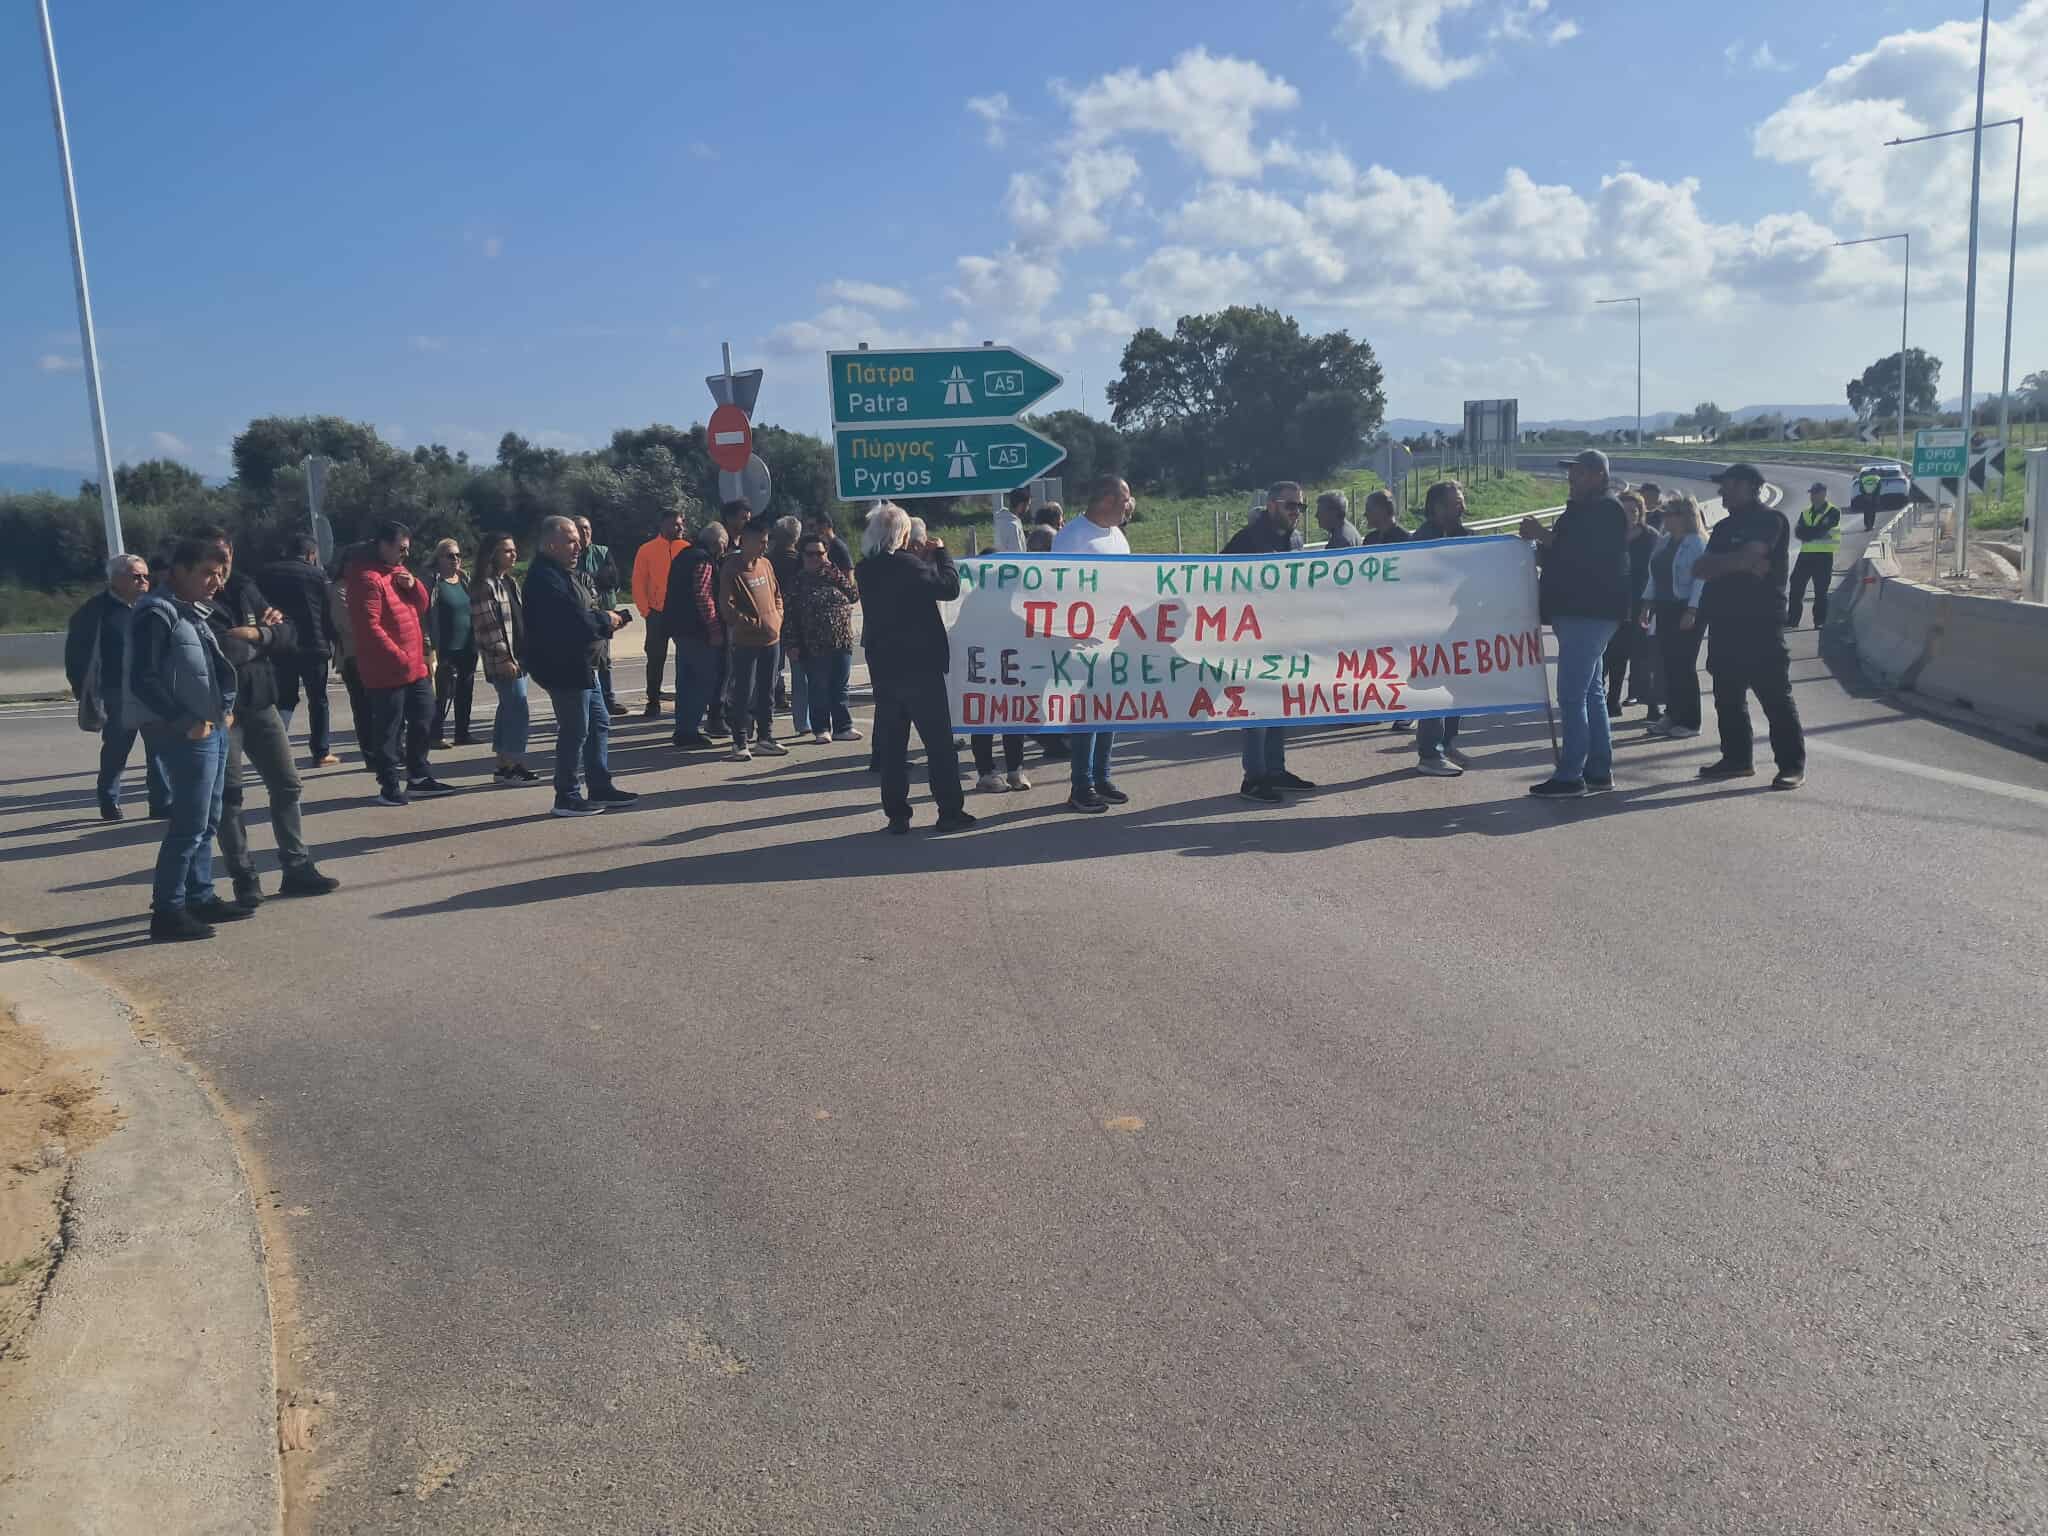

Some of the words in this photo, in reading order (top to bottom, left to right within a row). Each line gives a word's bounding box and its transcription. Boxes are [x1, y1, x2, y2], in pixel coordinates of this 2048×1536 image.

[847, 363, 915, 385] Πάτρα
[994, 376, 1016, 391] A5
[849, 393, 908, 413] Patra
[852, 438, 935, 463] Πύργος
[998, 450, 1018, 465] A5
[1926, 448, 1956, 459] ΟΡΙΟ
[1918, 462, 1961, 473] ΕΡΓΟΥ
[854, 468, 932, 492] Pyrgos
[957, 563, 1099, 592] ΑΓΡΟΤΗ
[1156, 556, 1401, 594] ΚΤΗΝΟΤΡΟΦΕ
[1023, 600, 1263, 643] ΠΟΛΕΜΑ
[1335, 646, 1400, 680] ΜΑΣ
[1409, 628, 1543, 679] ΚΛΕΒΟΥΝ
[1281, 682, 1408, 717] ΗΛΕΙΑΣ
